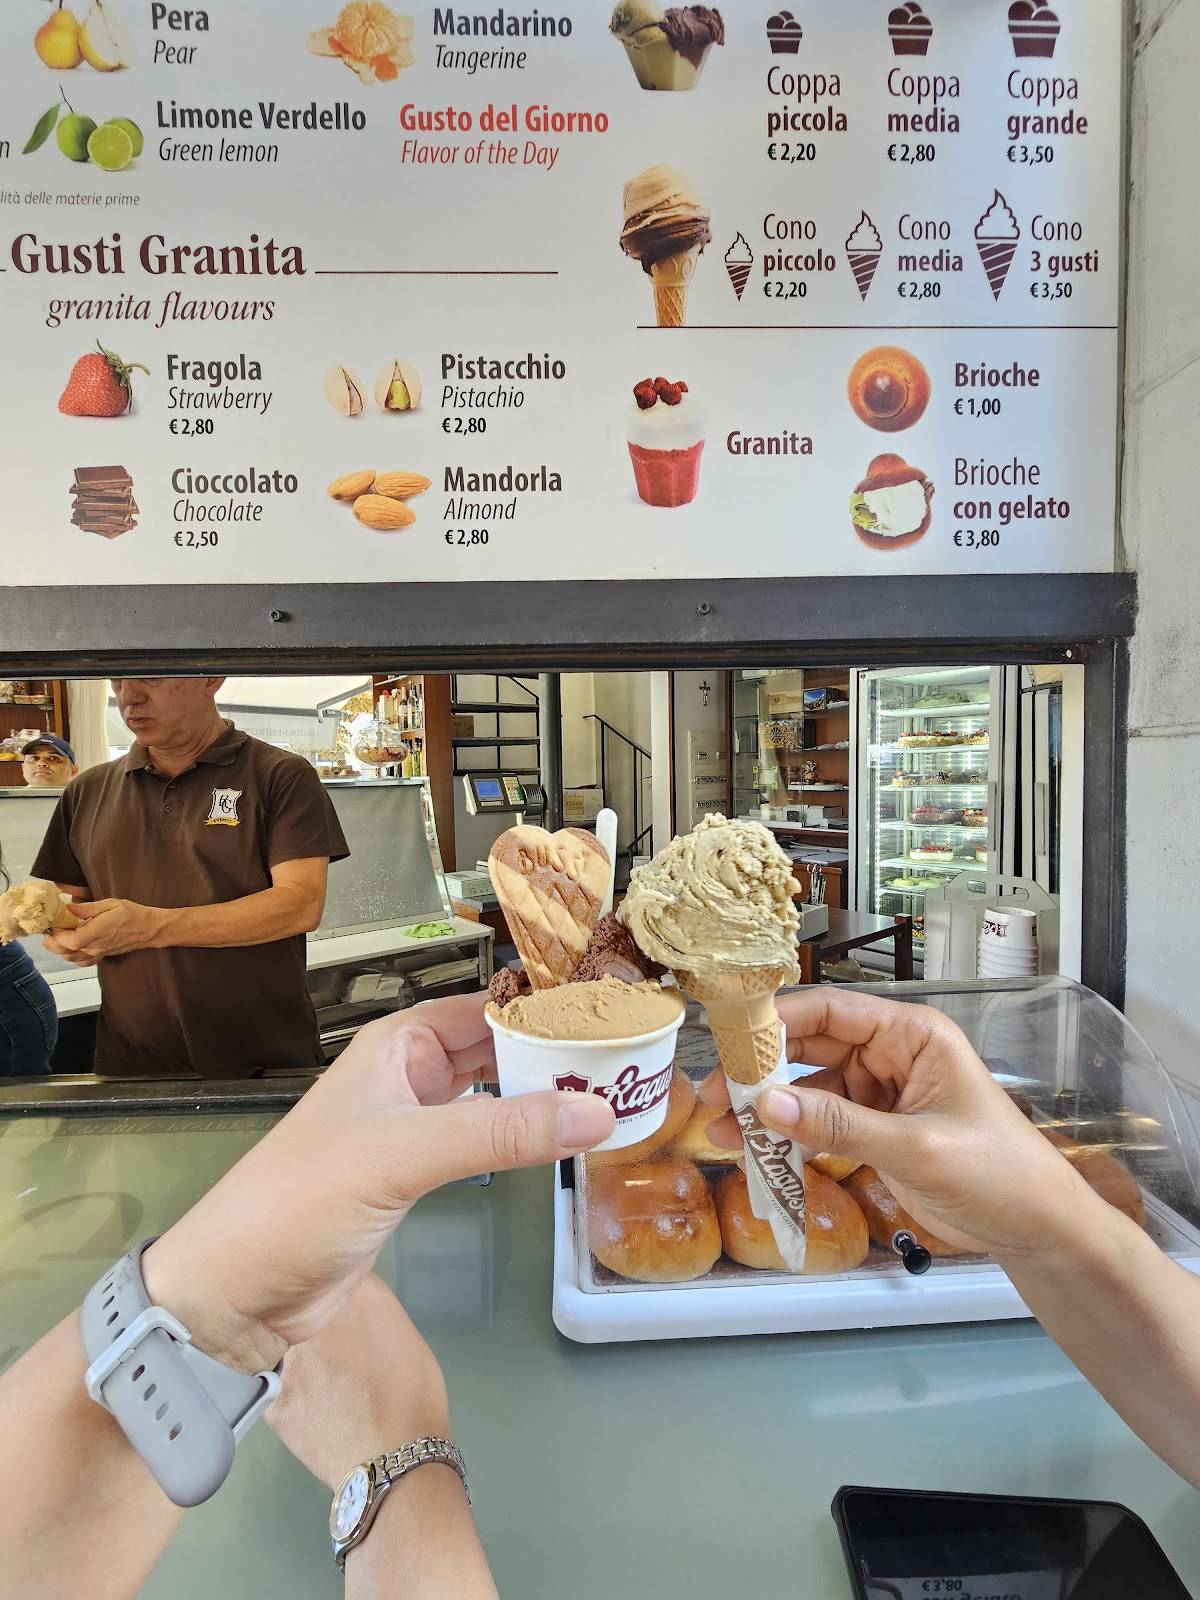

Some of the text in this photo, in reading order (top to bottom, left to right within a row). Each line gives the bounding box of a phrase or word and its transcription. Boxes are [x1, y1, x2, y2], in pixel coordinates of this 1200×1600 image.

[152, 3, 209, 31] Pera
[434, 8, 572, 37] Mandarino
[154, 40, 197, 64] Pear
[436, 45, 526, 74] Tangerine
[768, 66, 840, 103] Coppa
[888, 68, 959, 105] Coppa
[1008, 70, 1077, 106] Coppa
[157, 101, 366, 130] Limone Verdello
[400, 104, 608, 132] Gusto del Giorno
[768, 106, 847, 137] piccola
[888, 107, 959, 132] media
[1008, 109, 1088, 140] grande
[160, 138, 278, 162] Green lemon
[402, 140, 559, 170] Flavor of the Day
[25, 192, 52, 204] delle
[56, 193, 102, 205] materie
[105, 196, 139, 208] prime
[764, 214, 816, 239] Cono
[899, 214, 950, 240] Cono
[1032, 215, 1082, 240] Cono
[12, 233, 306, 275] Gusti Granita
[764, 249, 835, 277] piccolo
[899, 249, 962, 271] media
[1031, 250, 1098, 277] 3 gusti
[46, 291, 275, 328] granita flavours
[168, 354, 261, 388] Fragola
[442, 353, 565, 379] Pistacchio
[955, 362, 1039, 386] Brioche
[168, 384, 272, 414] Strawberry
[442, 385, 524, 407] Pistachio
[727, 430, 812, 455] Granita
[172, 467, 298, 493] Cioccolato
[444, 466, 561, 492] Mandorla
[955, 457, 1040, 485] Brioche
[174, 499, 262, 521] Chocolate
[444, 497, 516, 519] Almond
[954, 495, 1070, 524] con gelato
